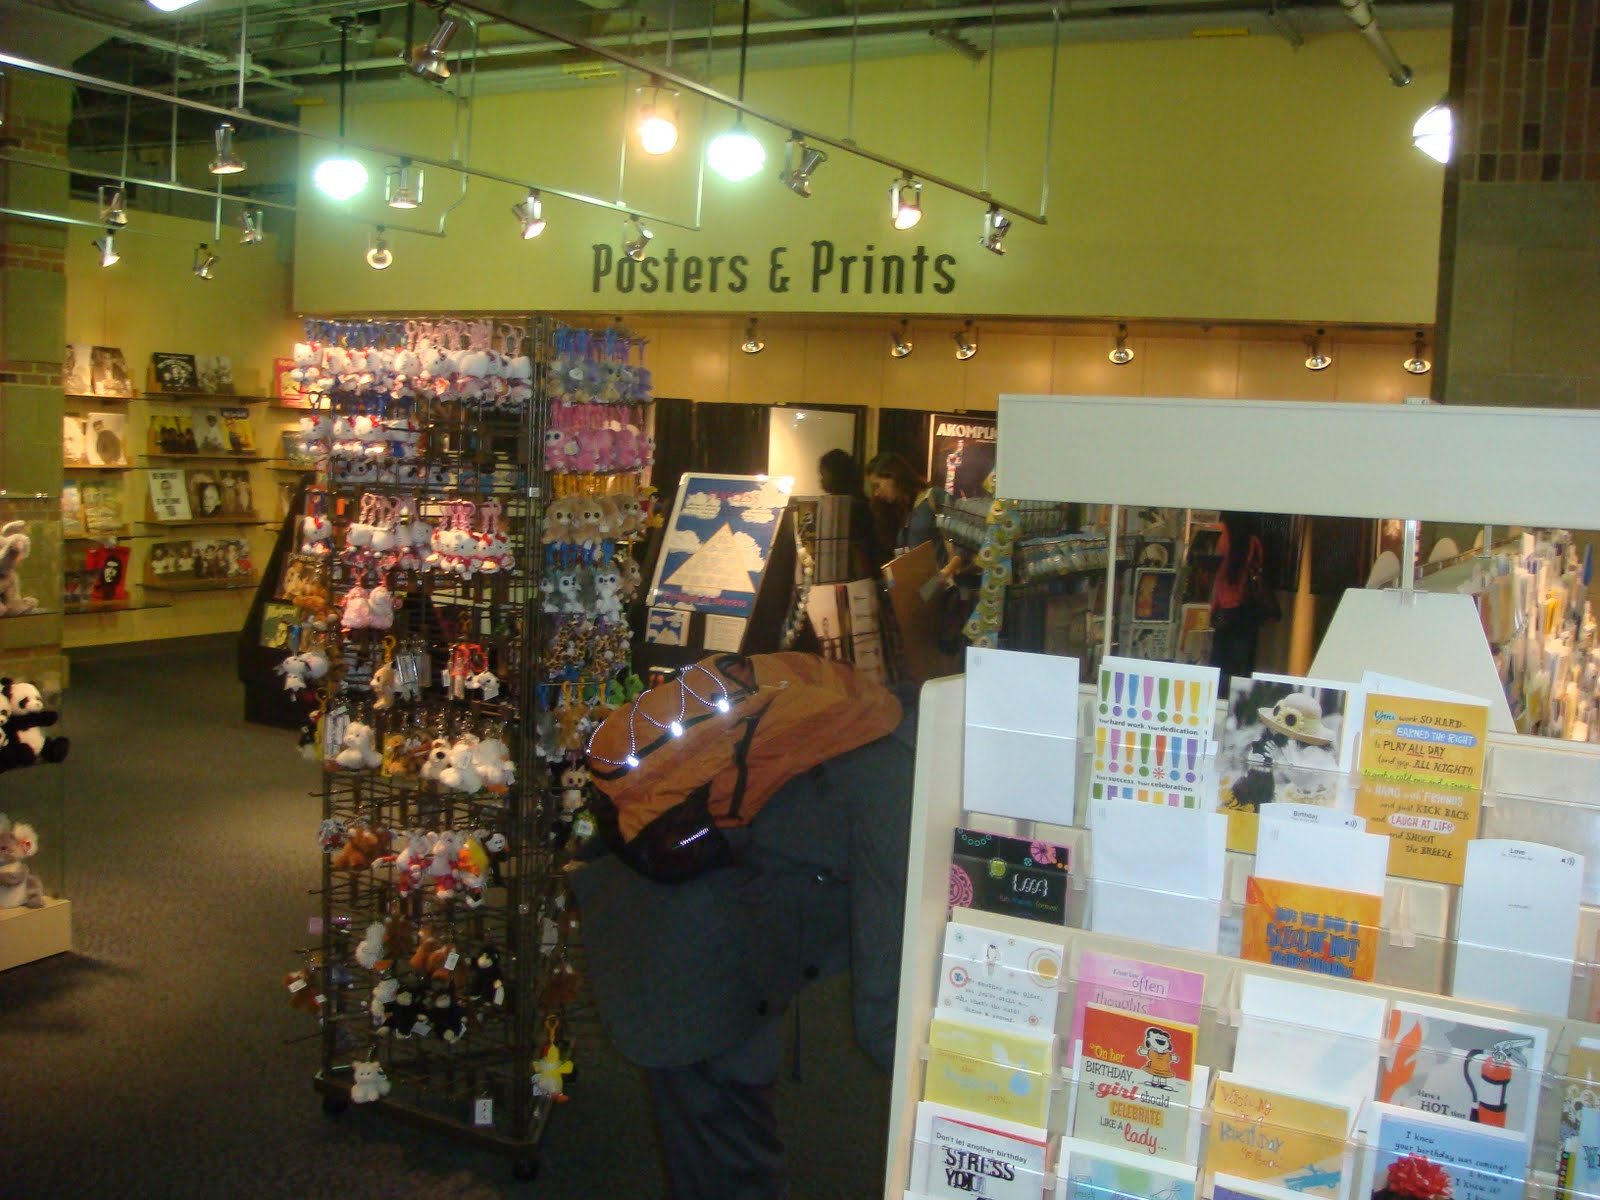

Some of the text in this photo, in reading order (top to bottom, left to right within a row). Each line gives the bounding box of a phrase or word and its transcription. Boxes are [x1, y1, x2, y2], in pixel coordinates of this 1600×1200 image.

[592, 240, 957, 294] Posters & Prints
[1420, 715, 1432, 724] SO
[1396, 727, 1430, 739] EARNED
[1384, 741, 1406, 752] PLAY
[1408, 744, 1424, 755] ALL
[1428, 746, 1446, 757] DAY
[1413, 760, 1430, 770] ALL
[1416, 804, 1441, 815] KICK
[1445, 808, 1470, 820] BACK
[1132, 977, 1165, 995] often
[1110, 1048, 1125, 1063] her
[1090, 1081, 1170, 1108] a girl should
[1111, 1101, 1161, 1126] CELEBRATE
[1421, 1100, 1451, 1115] HOT
[1100, 1116, 1117, 1129] LIKE
[1117, 1120, 1123, 1130] A
[1406, 1131, 1435, 1143] I knew
[936, 1132, 1027, 1164] Don't let another birthday
[1395, 1142, 1414, 1151] your
[1416, 1145, 1454, 1162] birthday
[1458, 1156, 1473, 1164] was
[942, 1145, 1016, 1181] STRESS
